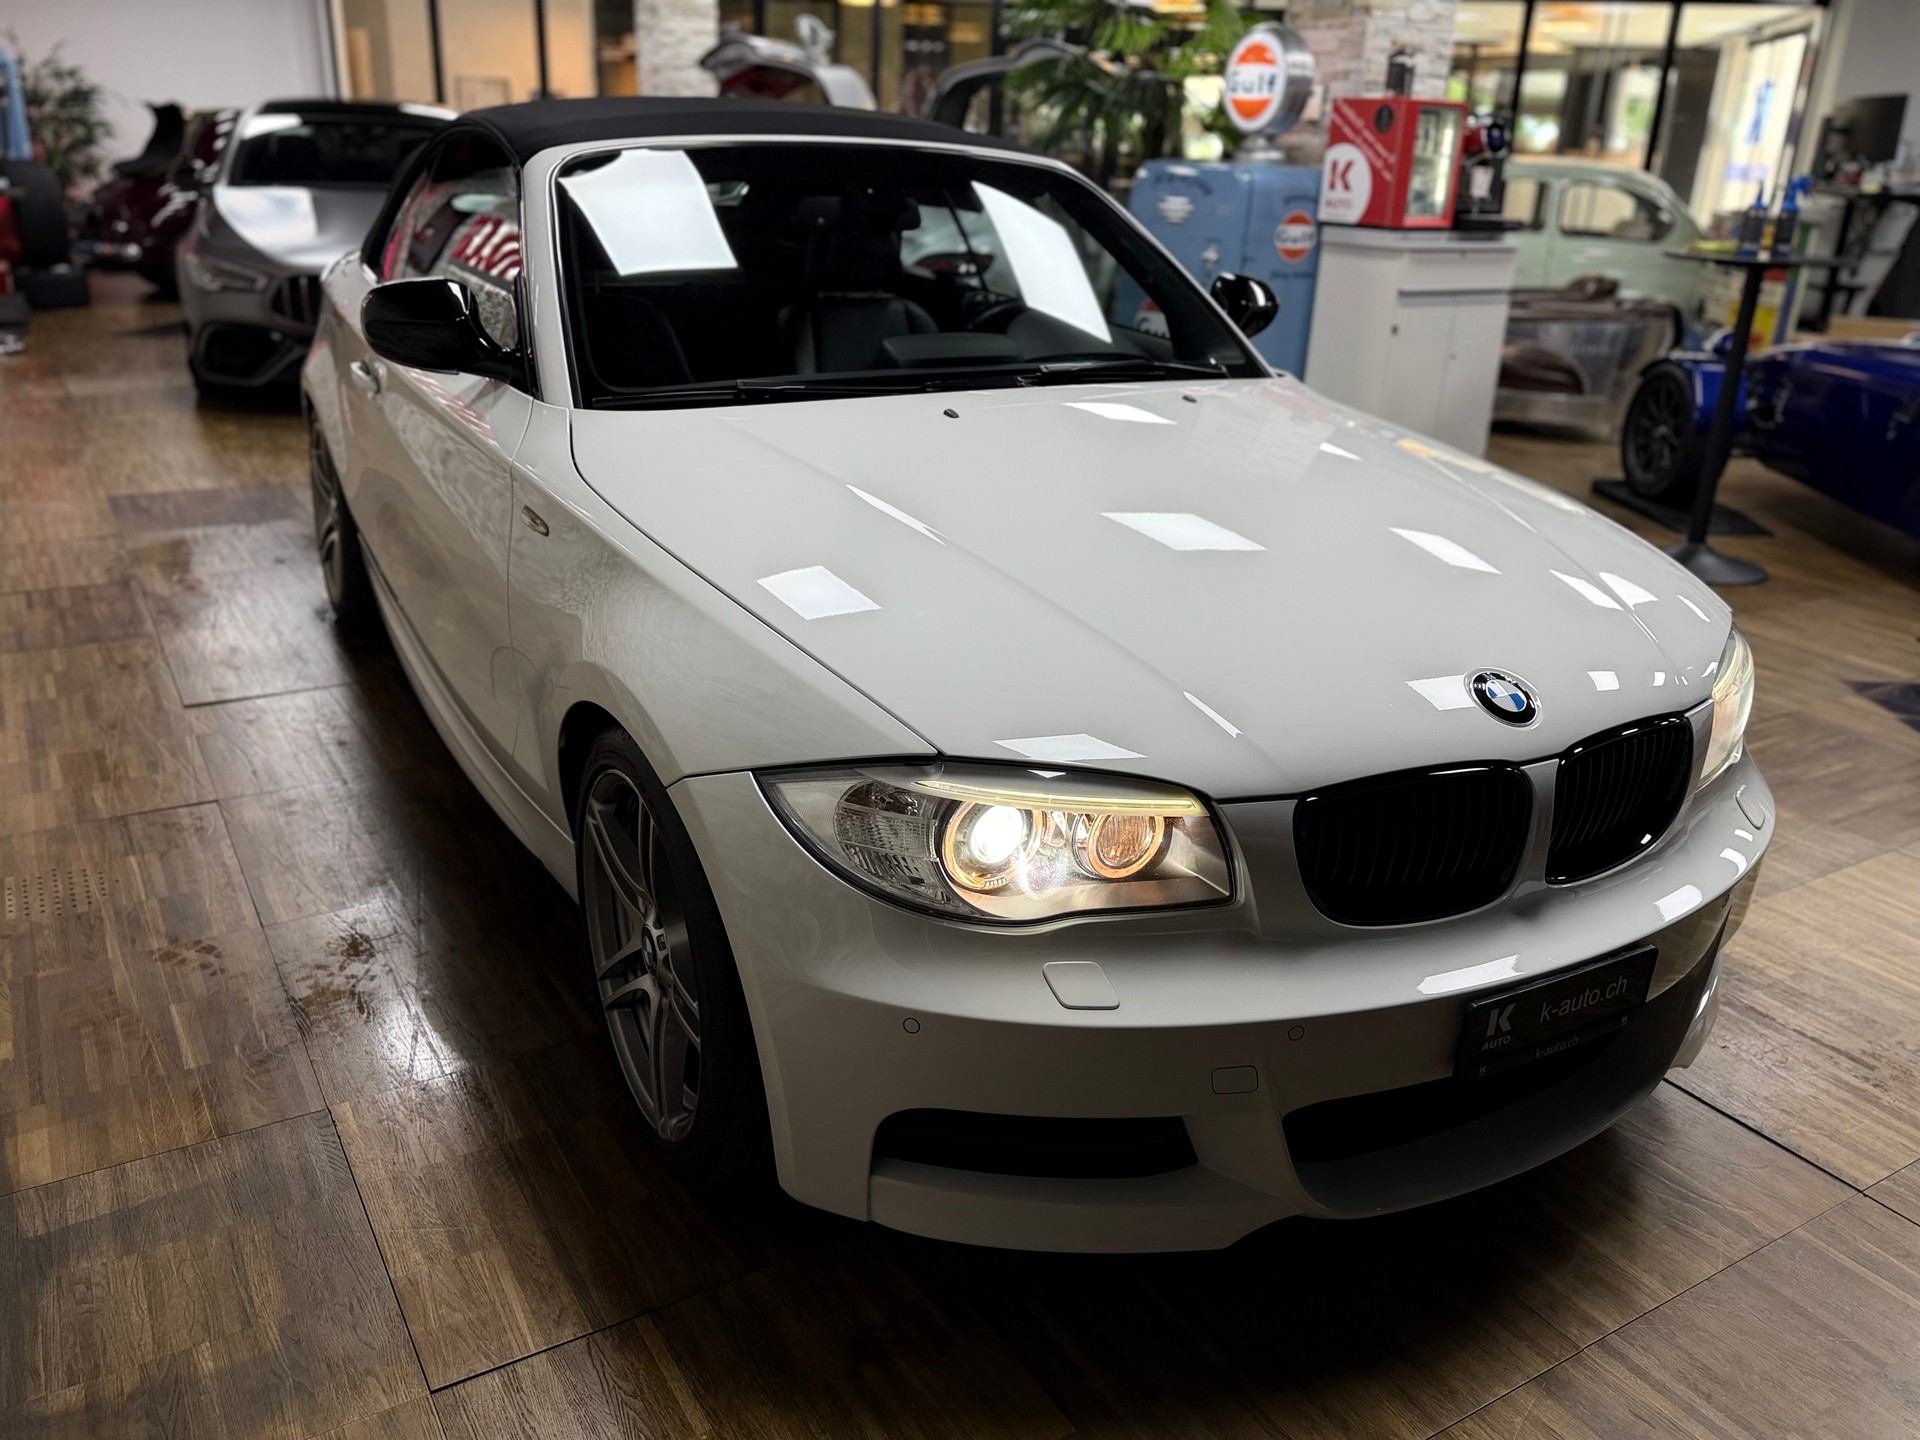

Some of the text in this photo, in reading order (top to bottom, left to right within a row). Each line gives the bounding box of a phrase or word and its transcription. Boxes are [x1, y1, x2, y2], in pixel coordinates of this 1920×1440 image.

[1229, 69, 1276, 94] Gulf
[1329, 160, 1354, 191] K
[1540, 975, 1628, 1023] k-auto.ch
[1486, 1002, 1517, 1037] K
[1481, 1035, 1511, 1052] AUTO
[1535, 1036, 1579, 1059] k-auto.ch
